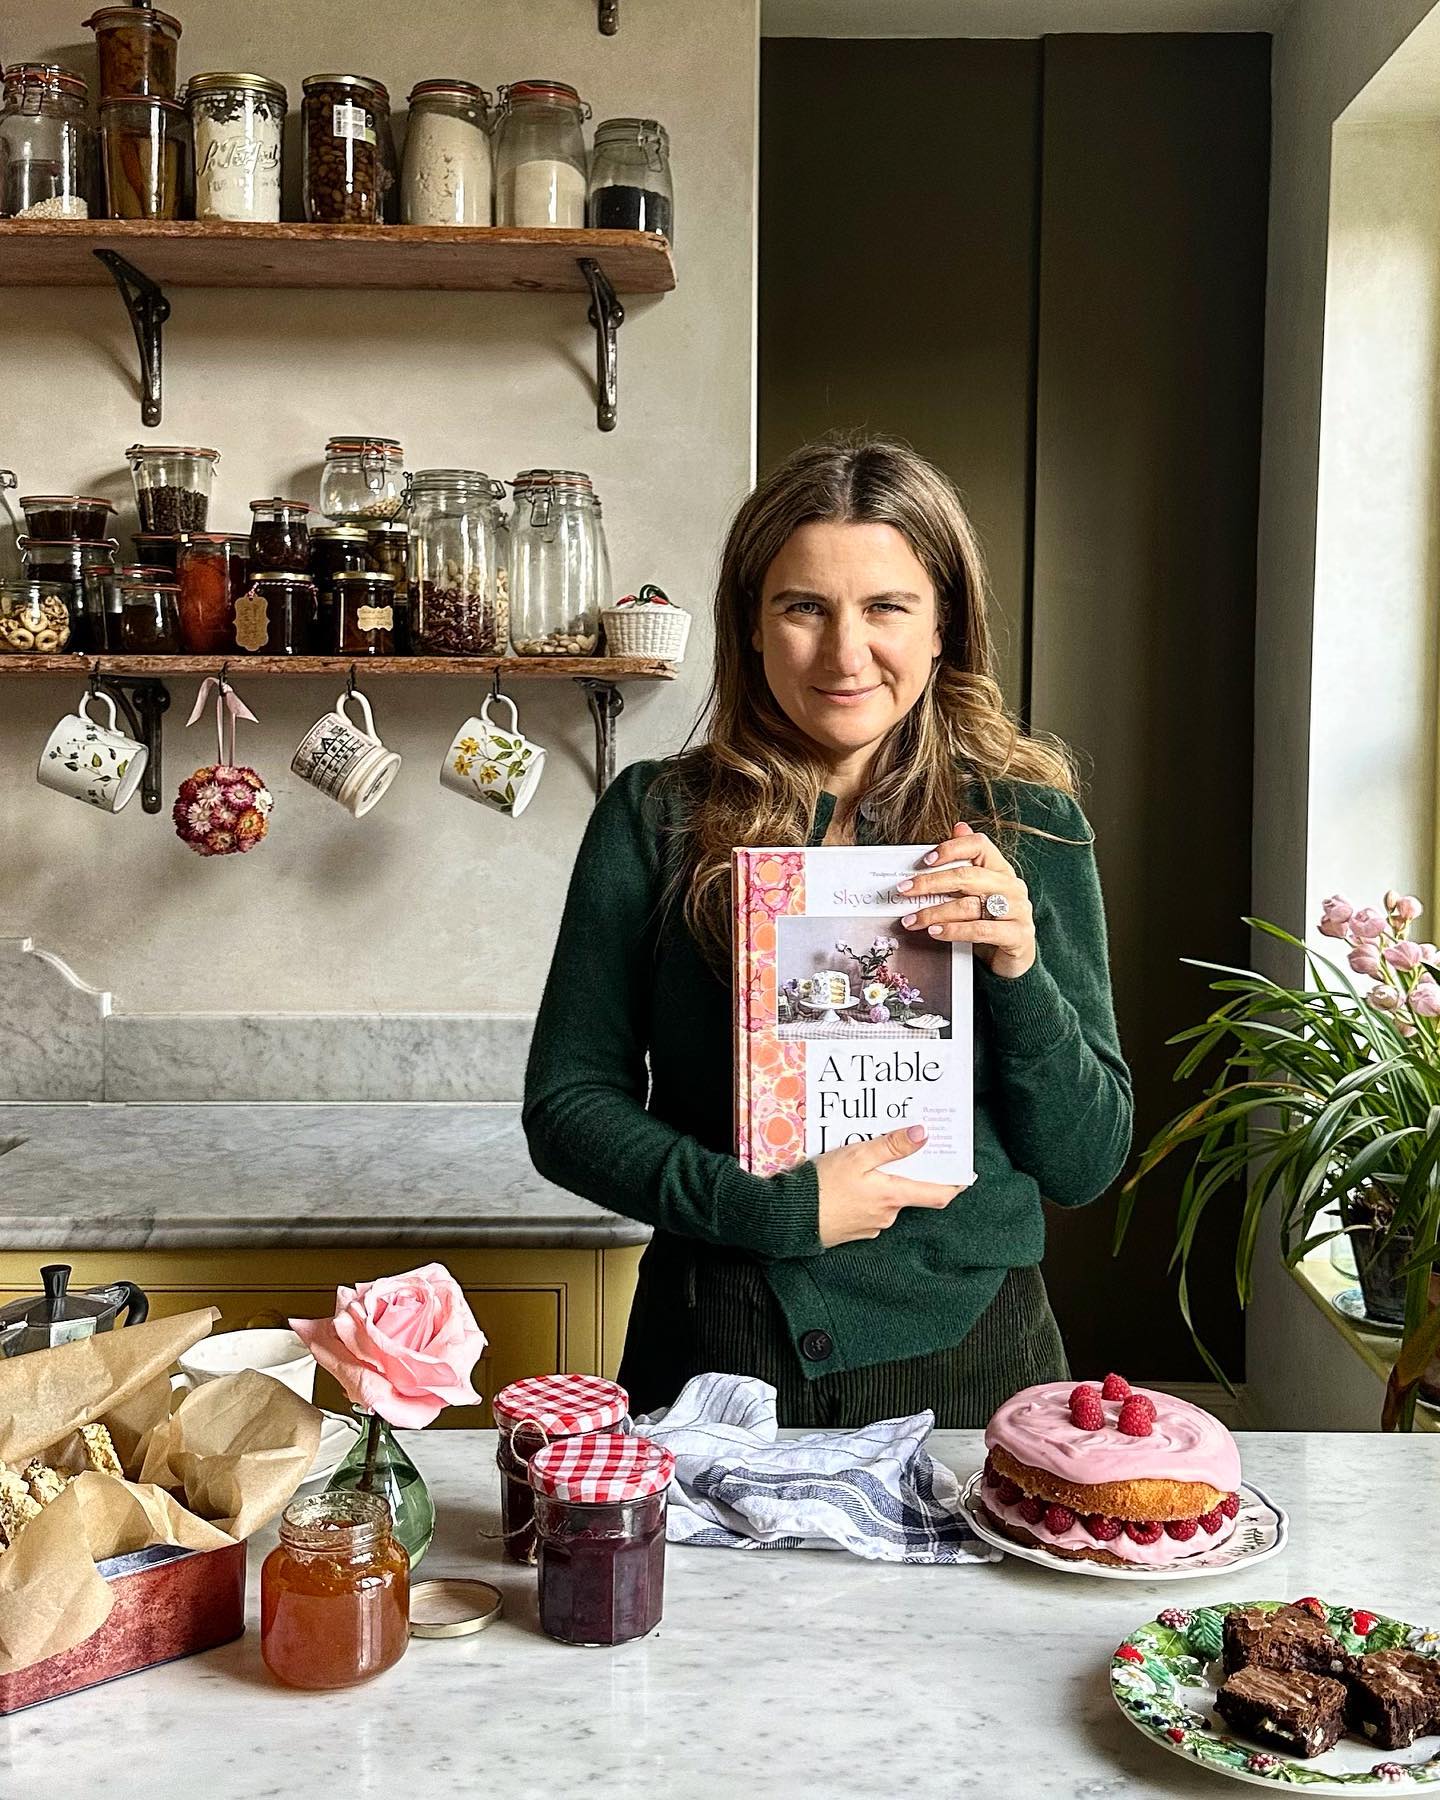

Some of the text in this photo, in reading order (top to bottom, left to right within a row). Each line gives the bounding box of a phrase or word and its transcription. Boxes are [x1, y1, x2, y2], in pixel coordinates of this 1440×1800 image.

[833, 888, 872, 908] Skye
[818, 1050, 945, 1082] A Table
[818, 1087, 914, 1119] Full of
